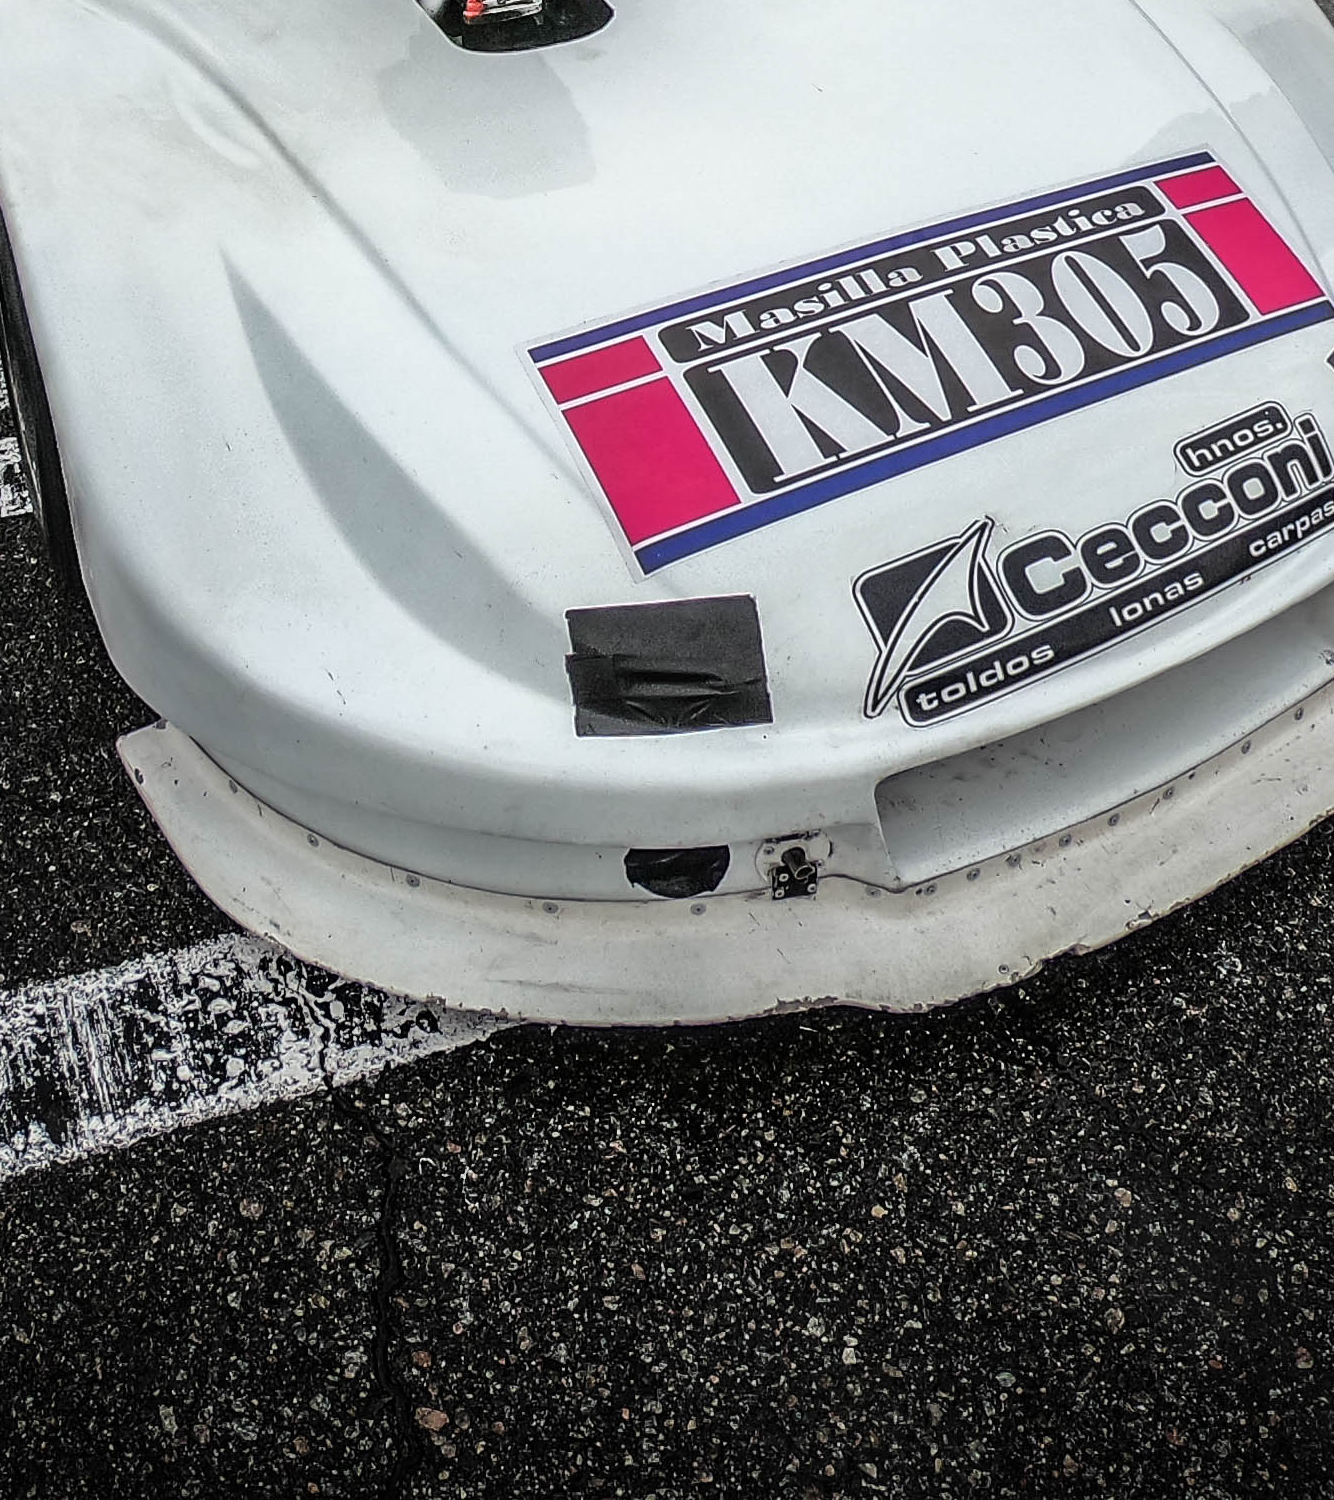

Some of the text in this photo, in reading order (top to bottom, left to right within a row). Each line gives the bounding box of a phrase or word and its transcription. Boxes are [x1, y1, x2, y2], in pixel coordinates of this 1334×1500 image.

[689, 195, 1146, 353] Masilla Plastica
[707, 225, 1224, 483] KM305
[1183, 411, 1288, 470] hnos.
[916, 639, 1055, 714] toldos
[1108, 567, 1206, 627] lonas
